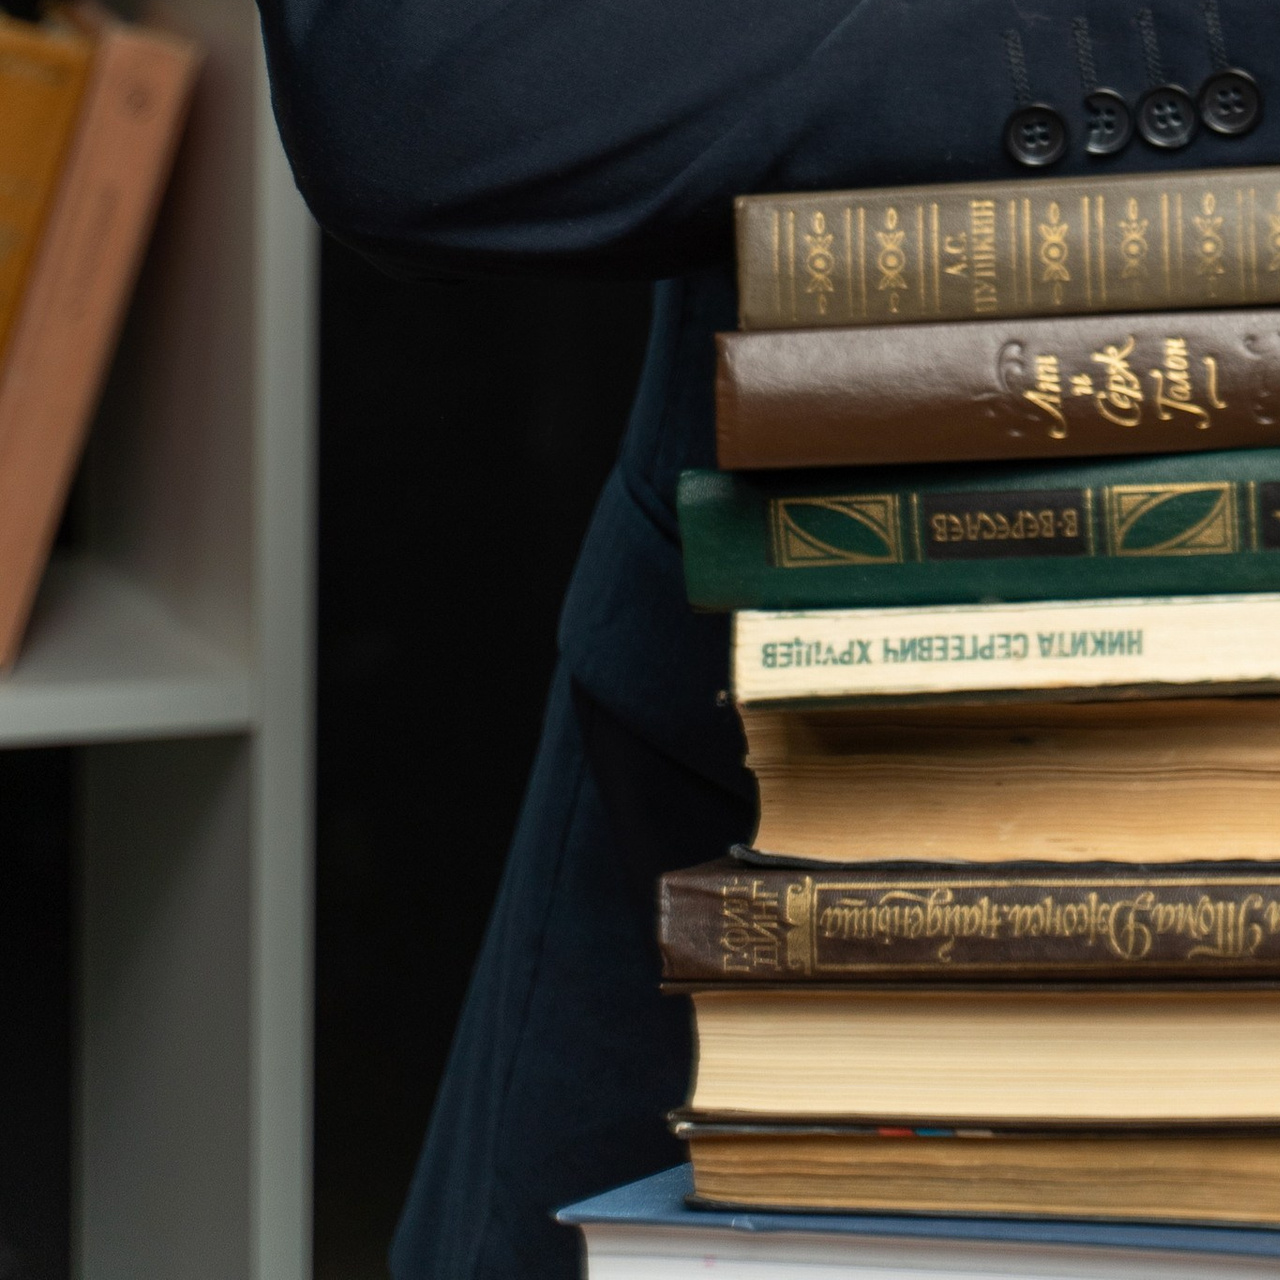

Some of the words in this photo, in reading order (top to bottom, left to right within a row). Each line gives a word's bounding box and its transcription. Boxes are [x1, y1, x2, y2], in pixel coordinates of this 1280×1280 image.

[1091, 334, 1144, 428] Серж
[882, 631, 1029, 664] СЕРГЕЕВИЧ
[1038, 628, 1144, 659] НИКИТА
[1153, 893, 1263, 959] Тома
